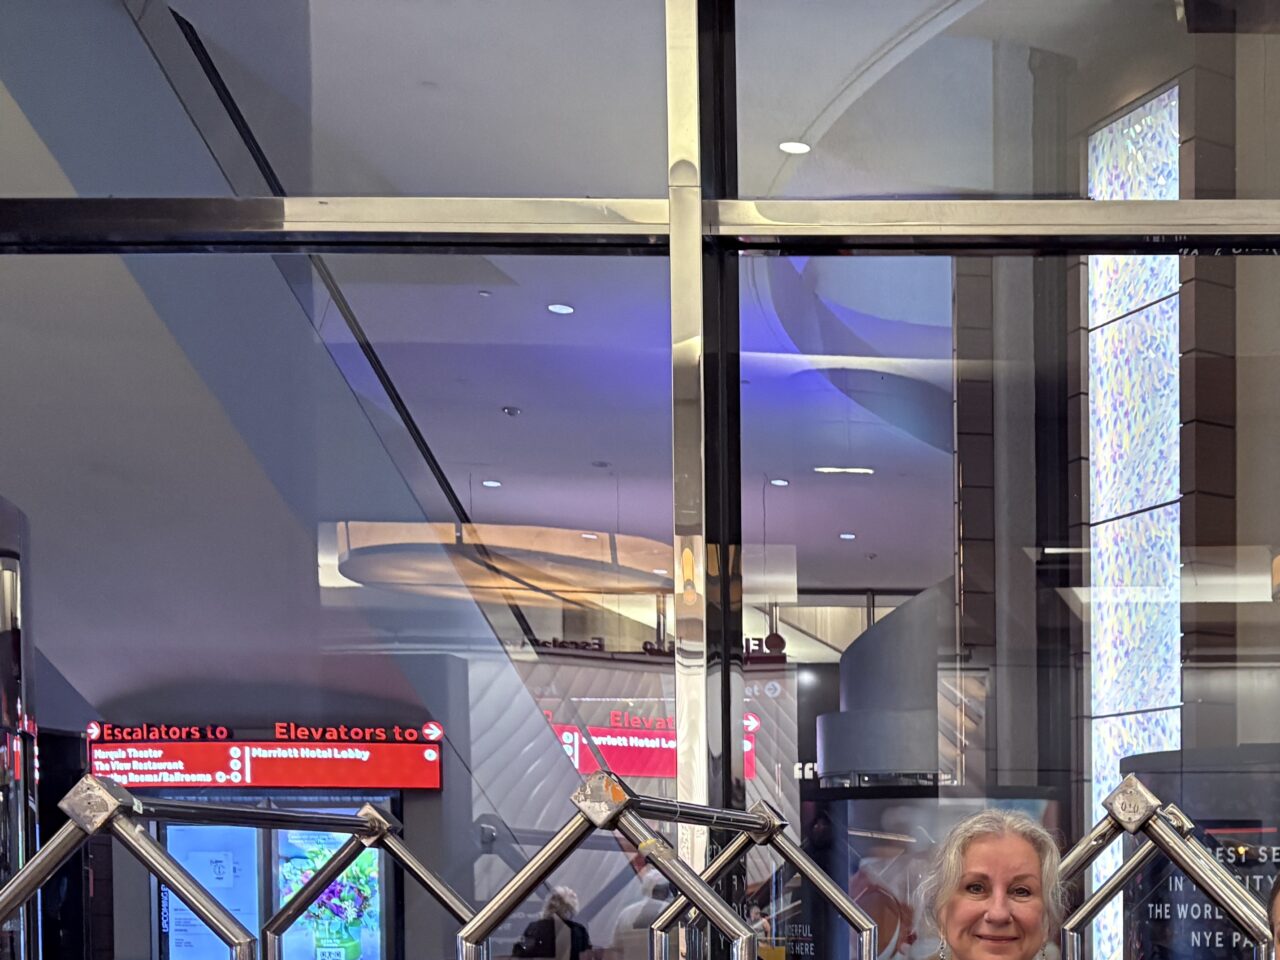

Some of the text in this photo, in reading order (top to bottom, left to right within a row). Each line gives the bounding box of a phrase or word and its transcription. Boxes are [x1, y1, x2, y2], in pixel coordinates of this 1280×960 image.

[609, 710, 675, 729] Elevat
[103, 723, 228, 740] Escalators to
[274, 722, 418, 741] Elevators to
[127, 748, 163, 759] Theater
[251, 747, 299, 759] Marriott
[301, 747, 332, 759] Hotel
[333, 747, 370, 761] Lobby
[94, 760, 184, 771] The View Restaurant
[1168, 876, 1184, 892] IN
[160, 891, 169, 932] UPCOMING
[1147, 903, 1225, 920] THE WORL
[1190, 931, 1255, 948] NYE PA
